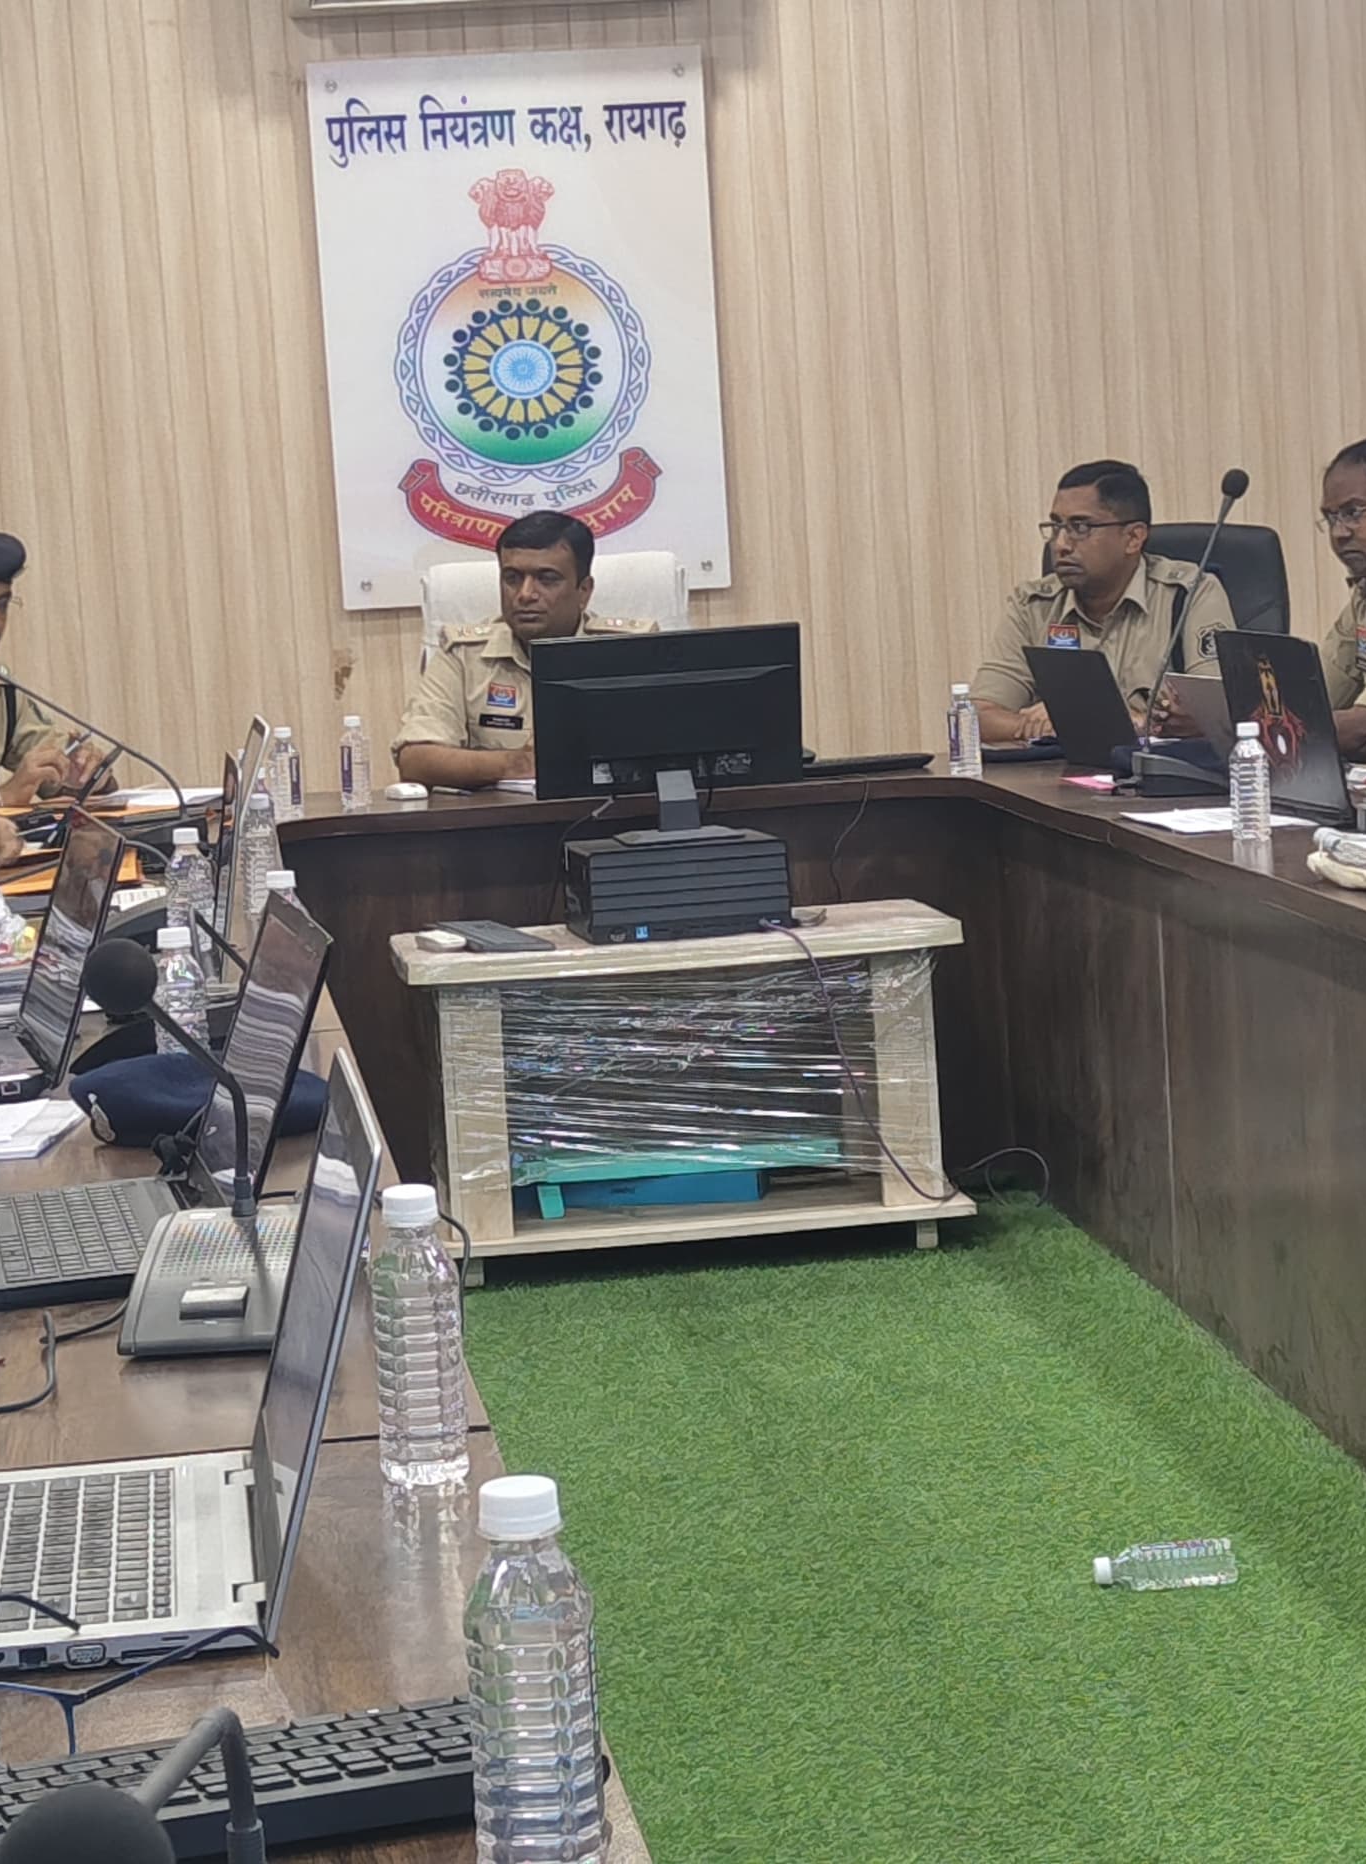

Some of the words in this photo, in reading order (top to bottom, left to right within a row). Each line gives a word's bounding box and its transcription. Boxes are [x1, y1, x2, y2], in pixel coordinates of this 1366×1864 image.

[325, 97, 407, 168] पुलिस
[419, 95, 515, 151] नियंत्रण
[528, 105, 591, 153] कक्ष,
[603, 101, 686, 148] रायगढ़
[543, 478, 597, 507] पुलिस
